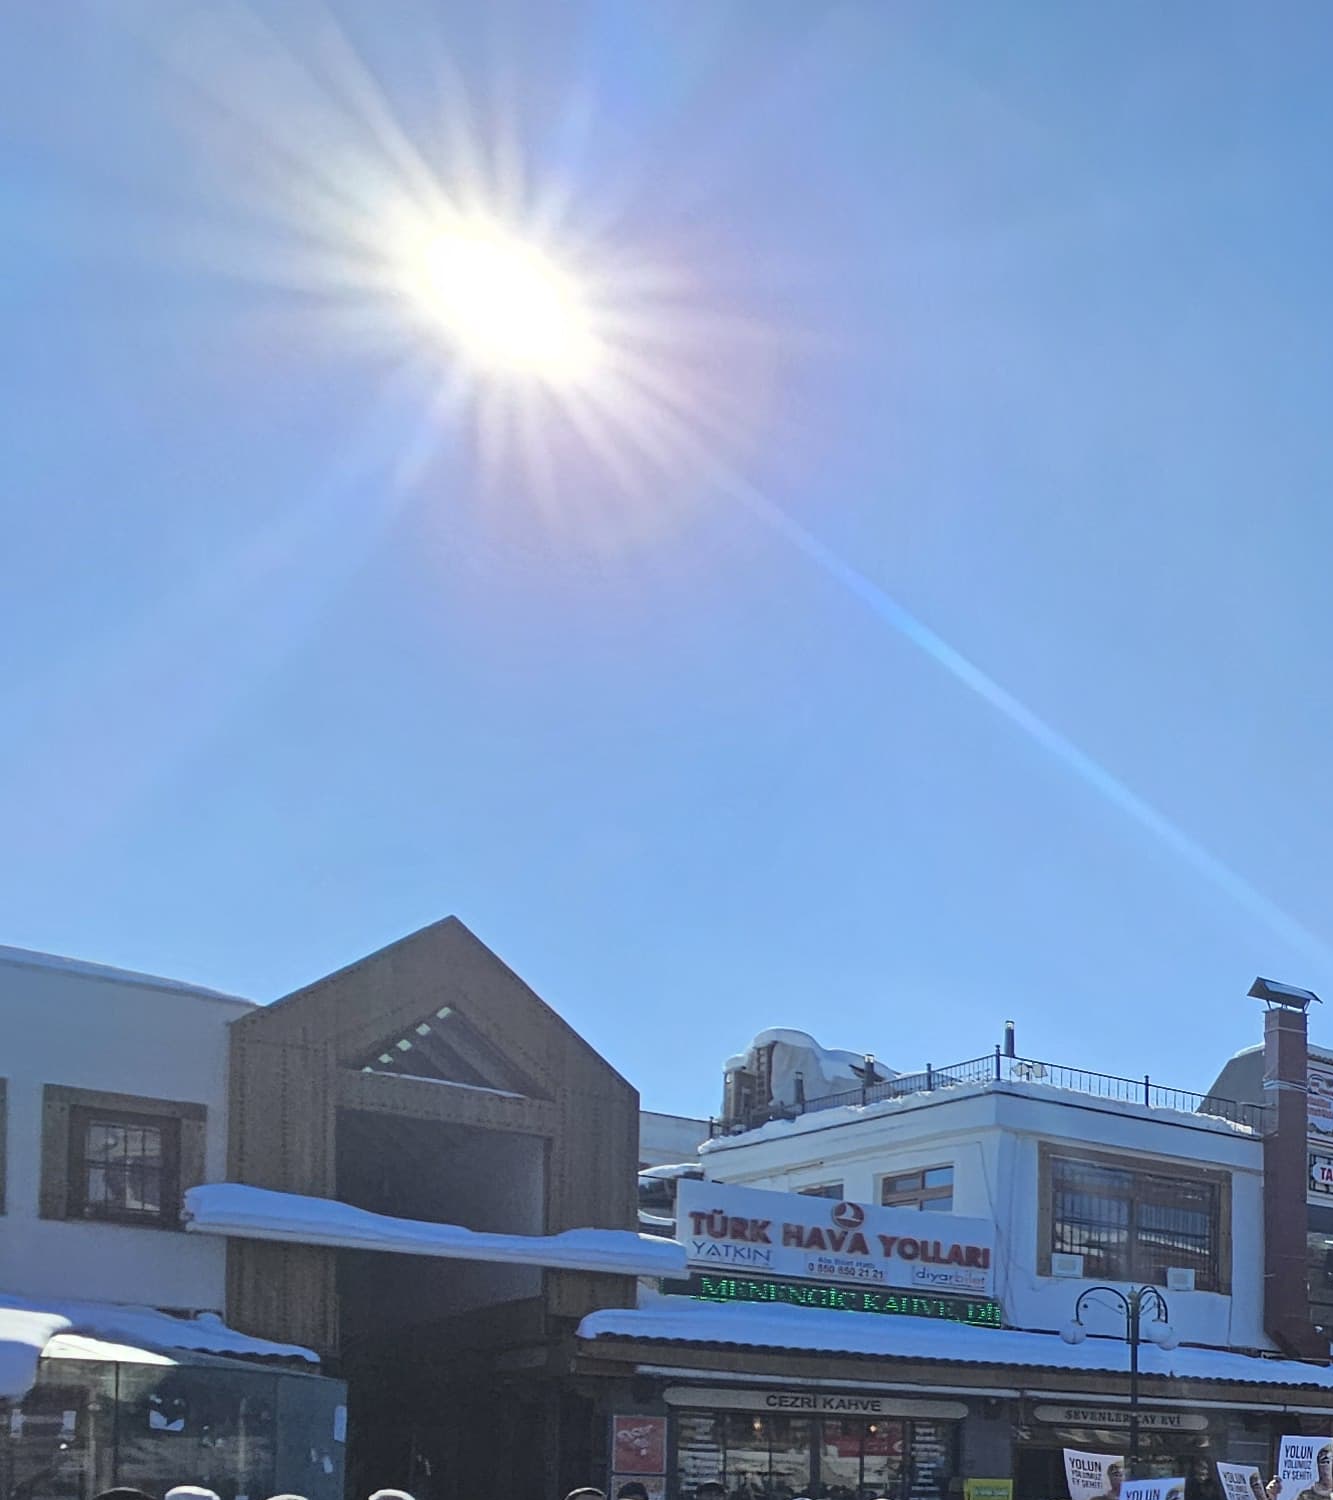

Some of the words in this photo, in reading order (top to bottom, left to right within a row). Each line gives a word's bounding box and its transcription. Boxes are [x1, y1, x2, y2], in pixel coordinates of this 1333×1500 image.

[689, 1208, 773, 1244] TÜRK
[782, 1222, 871, 1256] HAVA
[877, 1233, 991, 1270] YOLLARI
[691, 1240, 771, 1263] YATKIN
[823, 1396, 882, 1412] KAHVE
[1284, 1444, 1314, 1459] YOLUN
[1068, 1456, 1102, 1473] YOLUN
